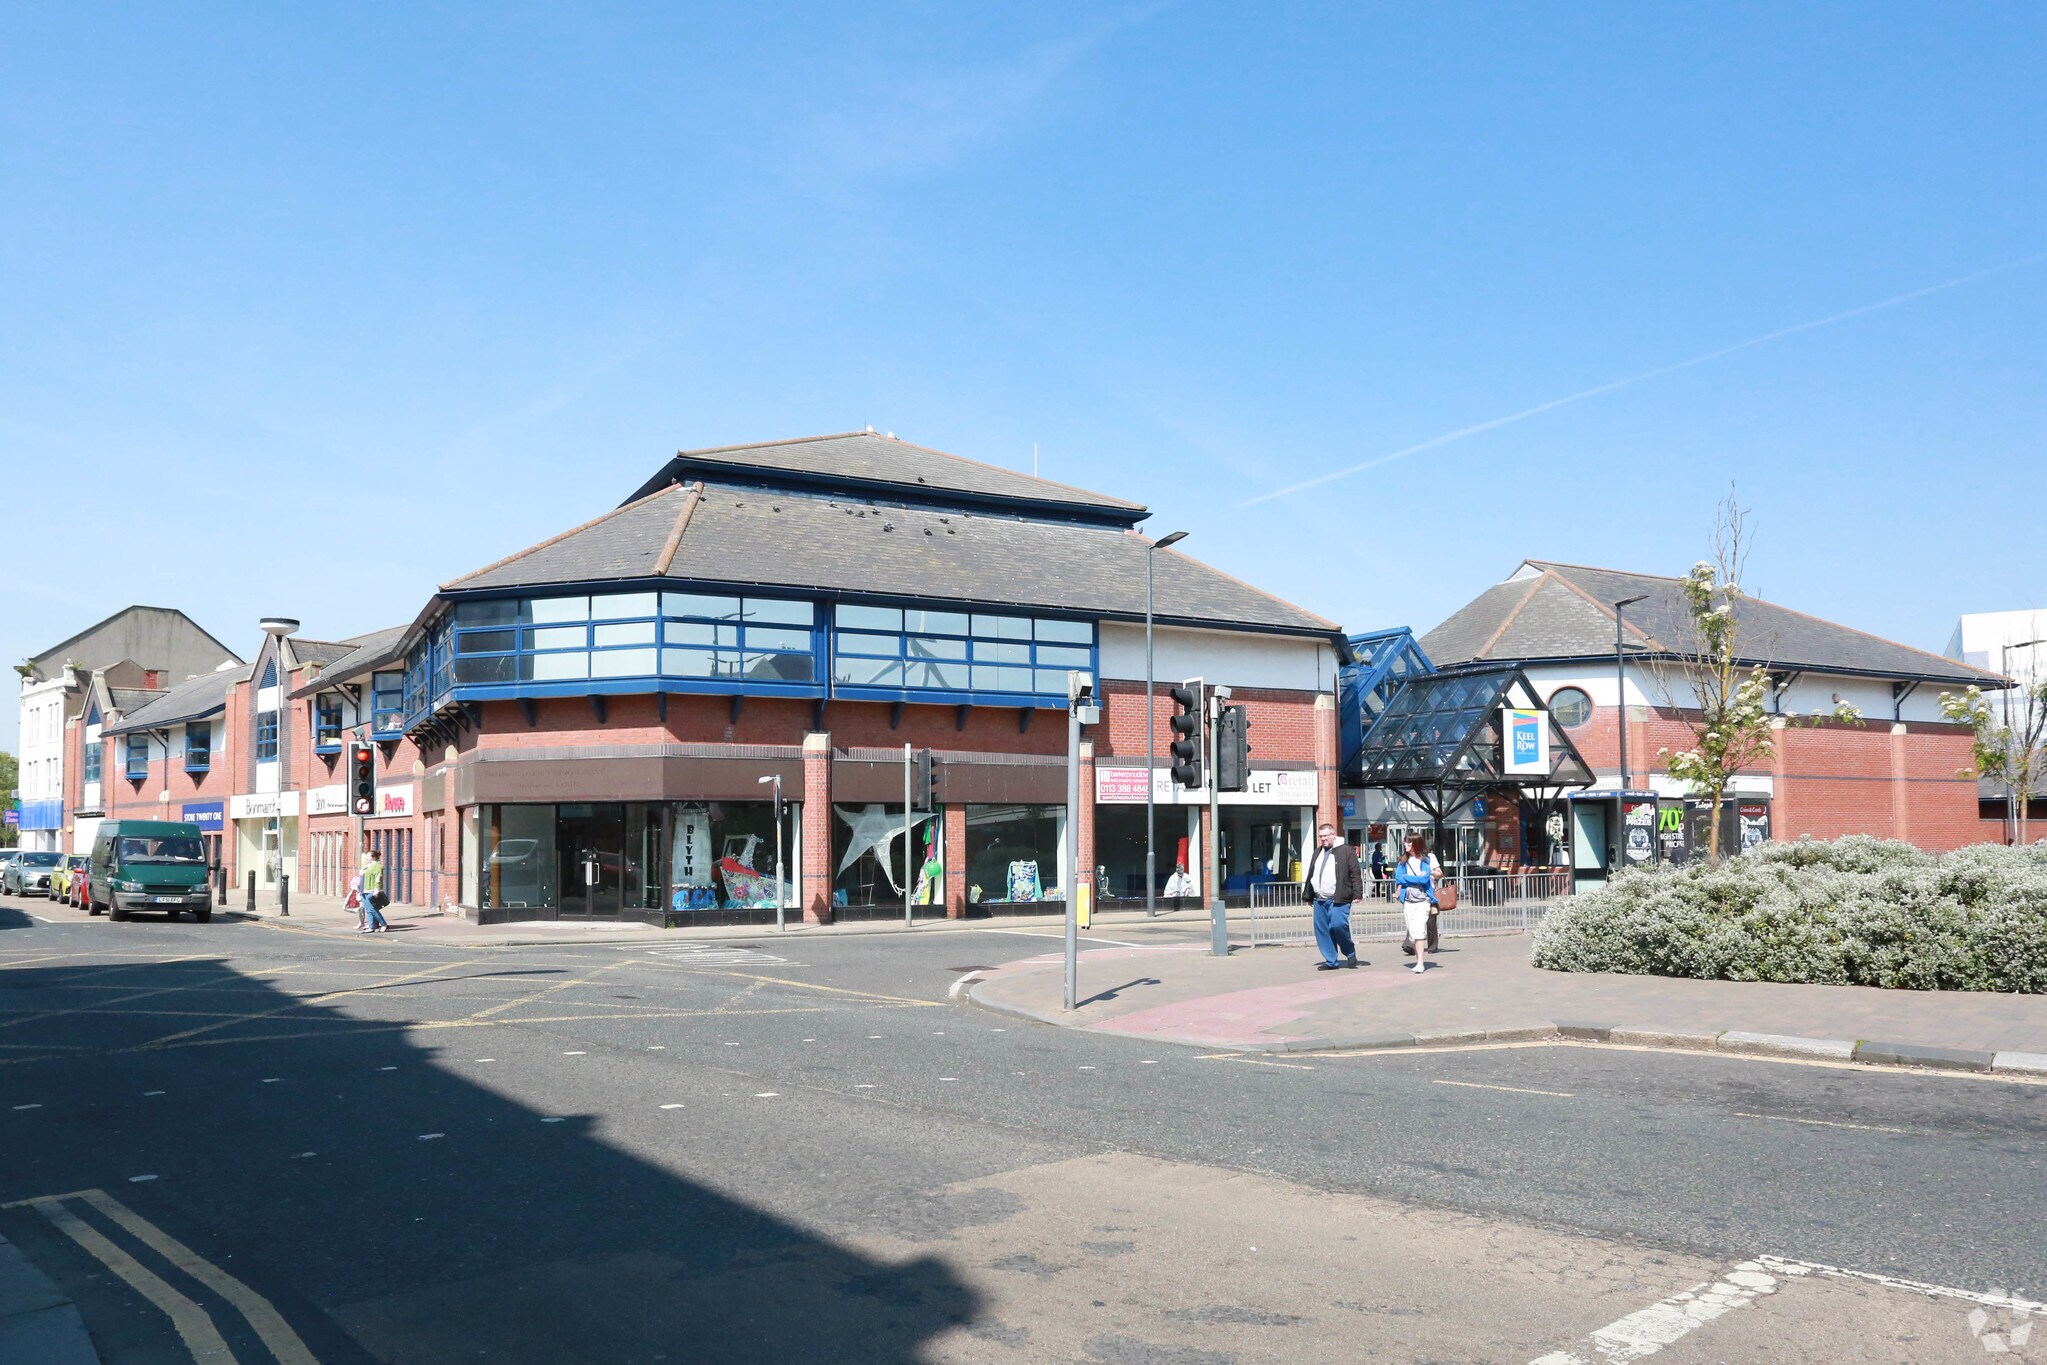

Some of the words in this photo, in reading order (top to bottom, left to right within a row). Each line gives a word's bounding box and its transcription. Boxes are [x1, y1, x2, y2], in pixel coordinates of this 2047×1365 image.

[1516, 731, 1536, 742] KEEL
[1516, 741, 1536, 752] ROW
[1100, 783, 1116, 793] 0113
[1117, 783, 1131, 793] 388
[1252, 782, 1272, 794] LET
[246, 797, 279, 815] Bonmarch
[1694, 801, 1724, 810] Telephe
[184, 813, 196, 822] STORE
[196, 812, 213, 821] TWENTY
[213, 811, 222, 820] ONE
[1672, 832, 1684, 840] STRE
[684, 824, 695, 877] BLYTH
